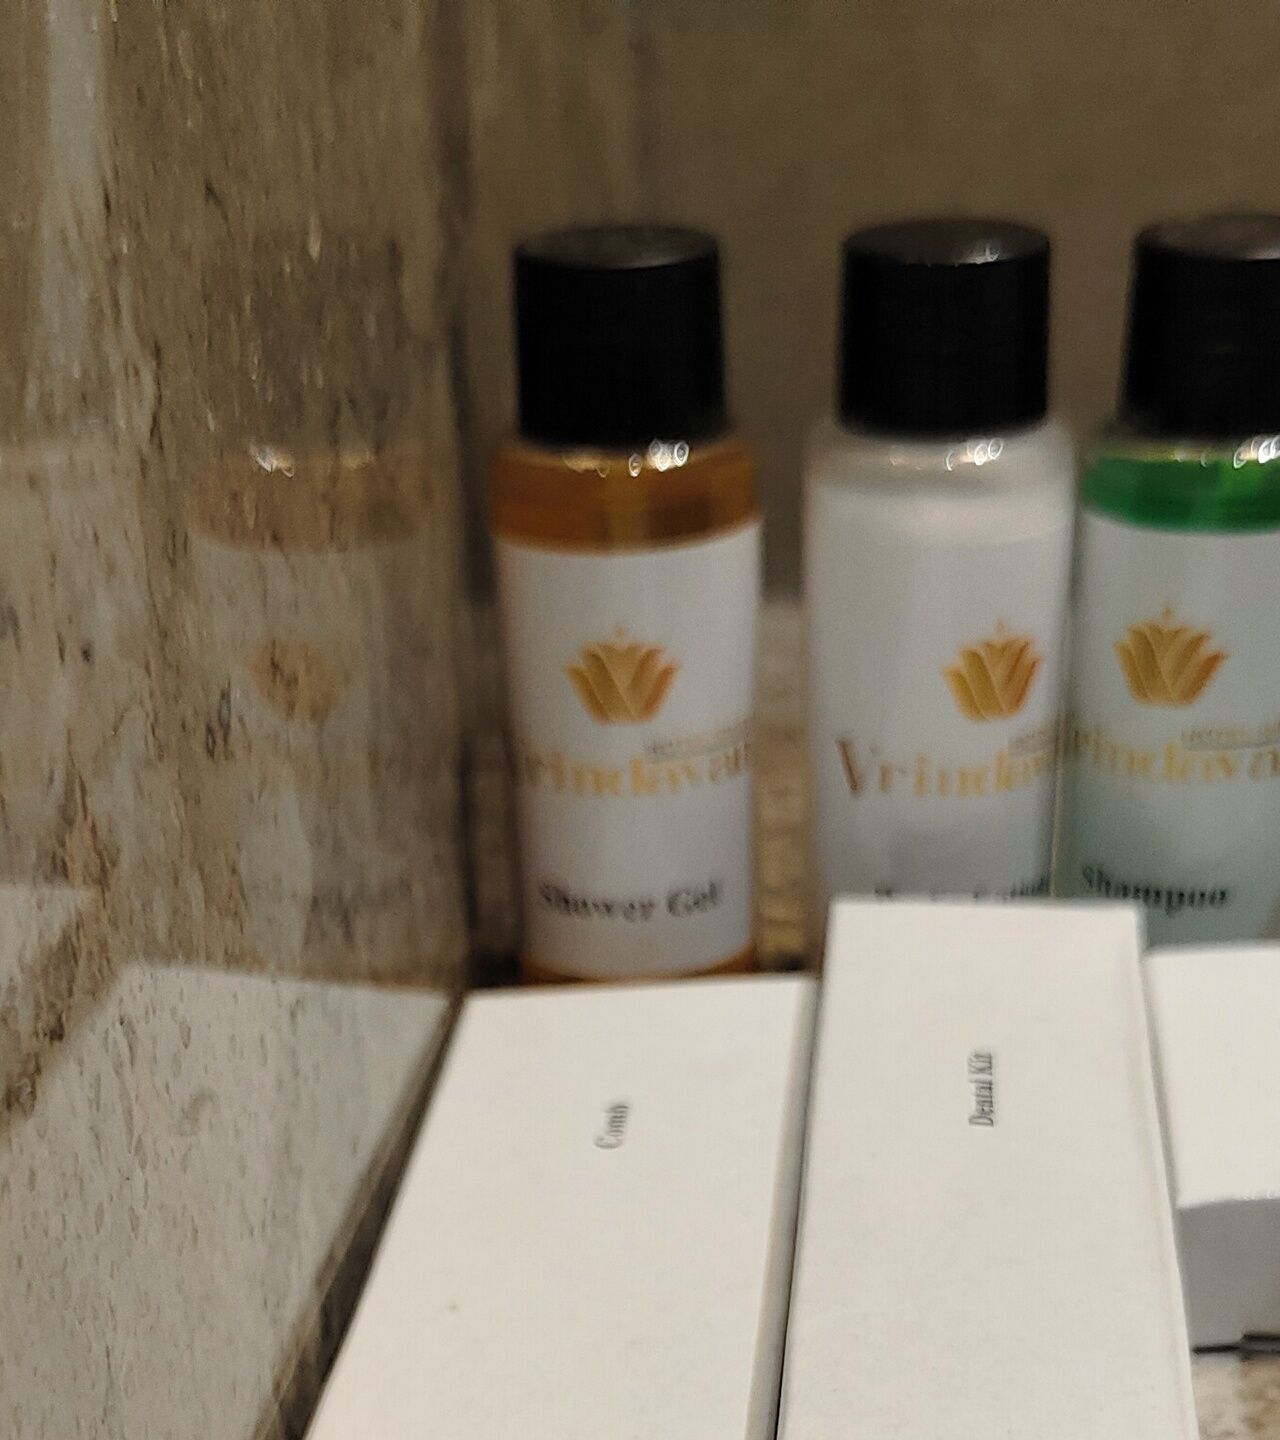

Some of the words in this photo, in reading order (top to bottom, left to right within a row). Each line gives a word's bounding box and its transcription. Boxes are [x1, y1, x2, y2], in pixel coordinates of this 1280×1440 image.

[540, 880, 655, 921] Shower
[666, 880, 721, 917] Gel
[966, 1052, 993, 1076] Kit
[967, 1079, 995, 1128] Dental
[594, 1104, 629, 1150] Comb
